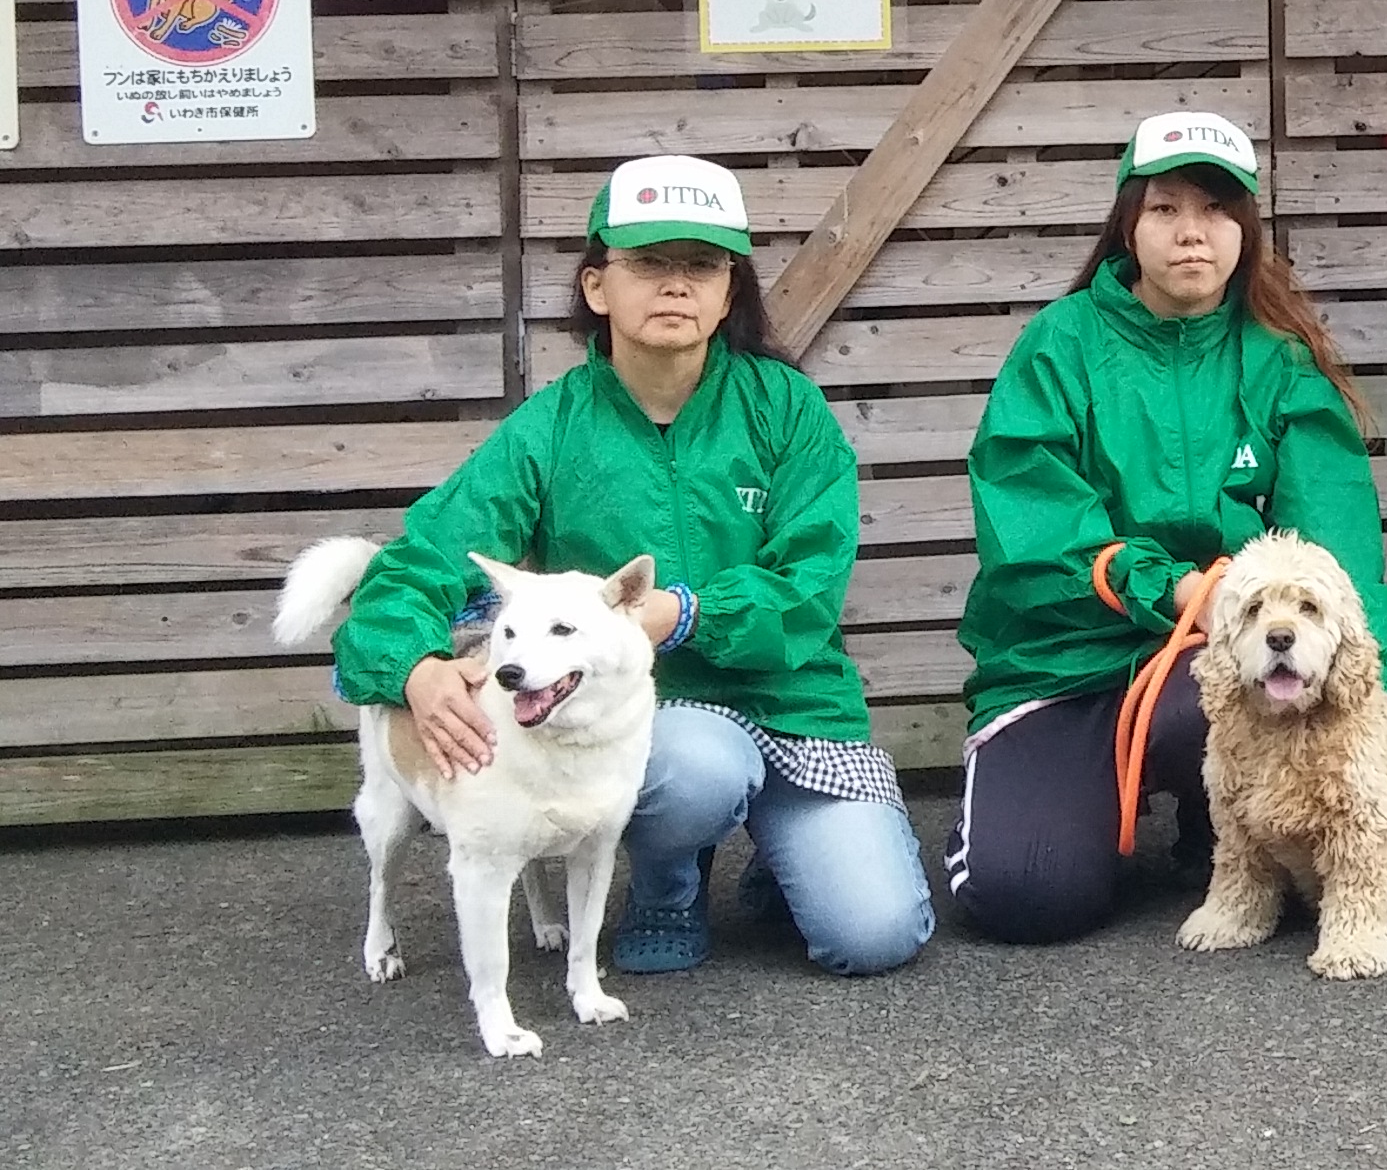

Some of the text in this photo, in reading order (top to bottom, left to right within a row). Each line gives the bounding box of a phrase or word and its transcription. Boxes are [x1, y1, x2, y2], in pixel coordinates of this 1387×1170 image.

[103, 67, 292, 86] フンは家にもちかえりましょう
[169, 105, 259, 119] いわき市保健所
[1187, 127, 1239, 152] ITDA
[662, 186, 726, 212] ITDA
